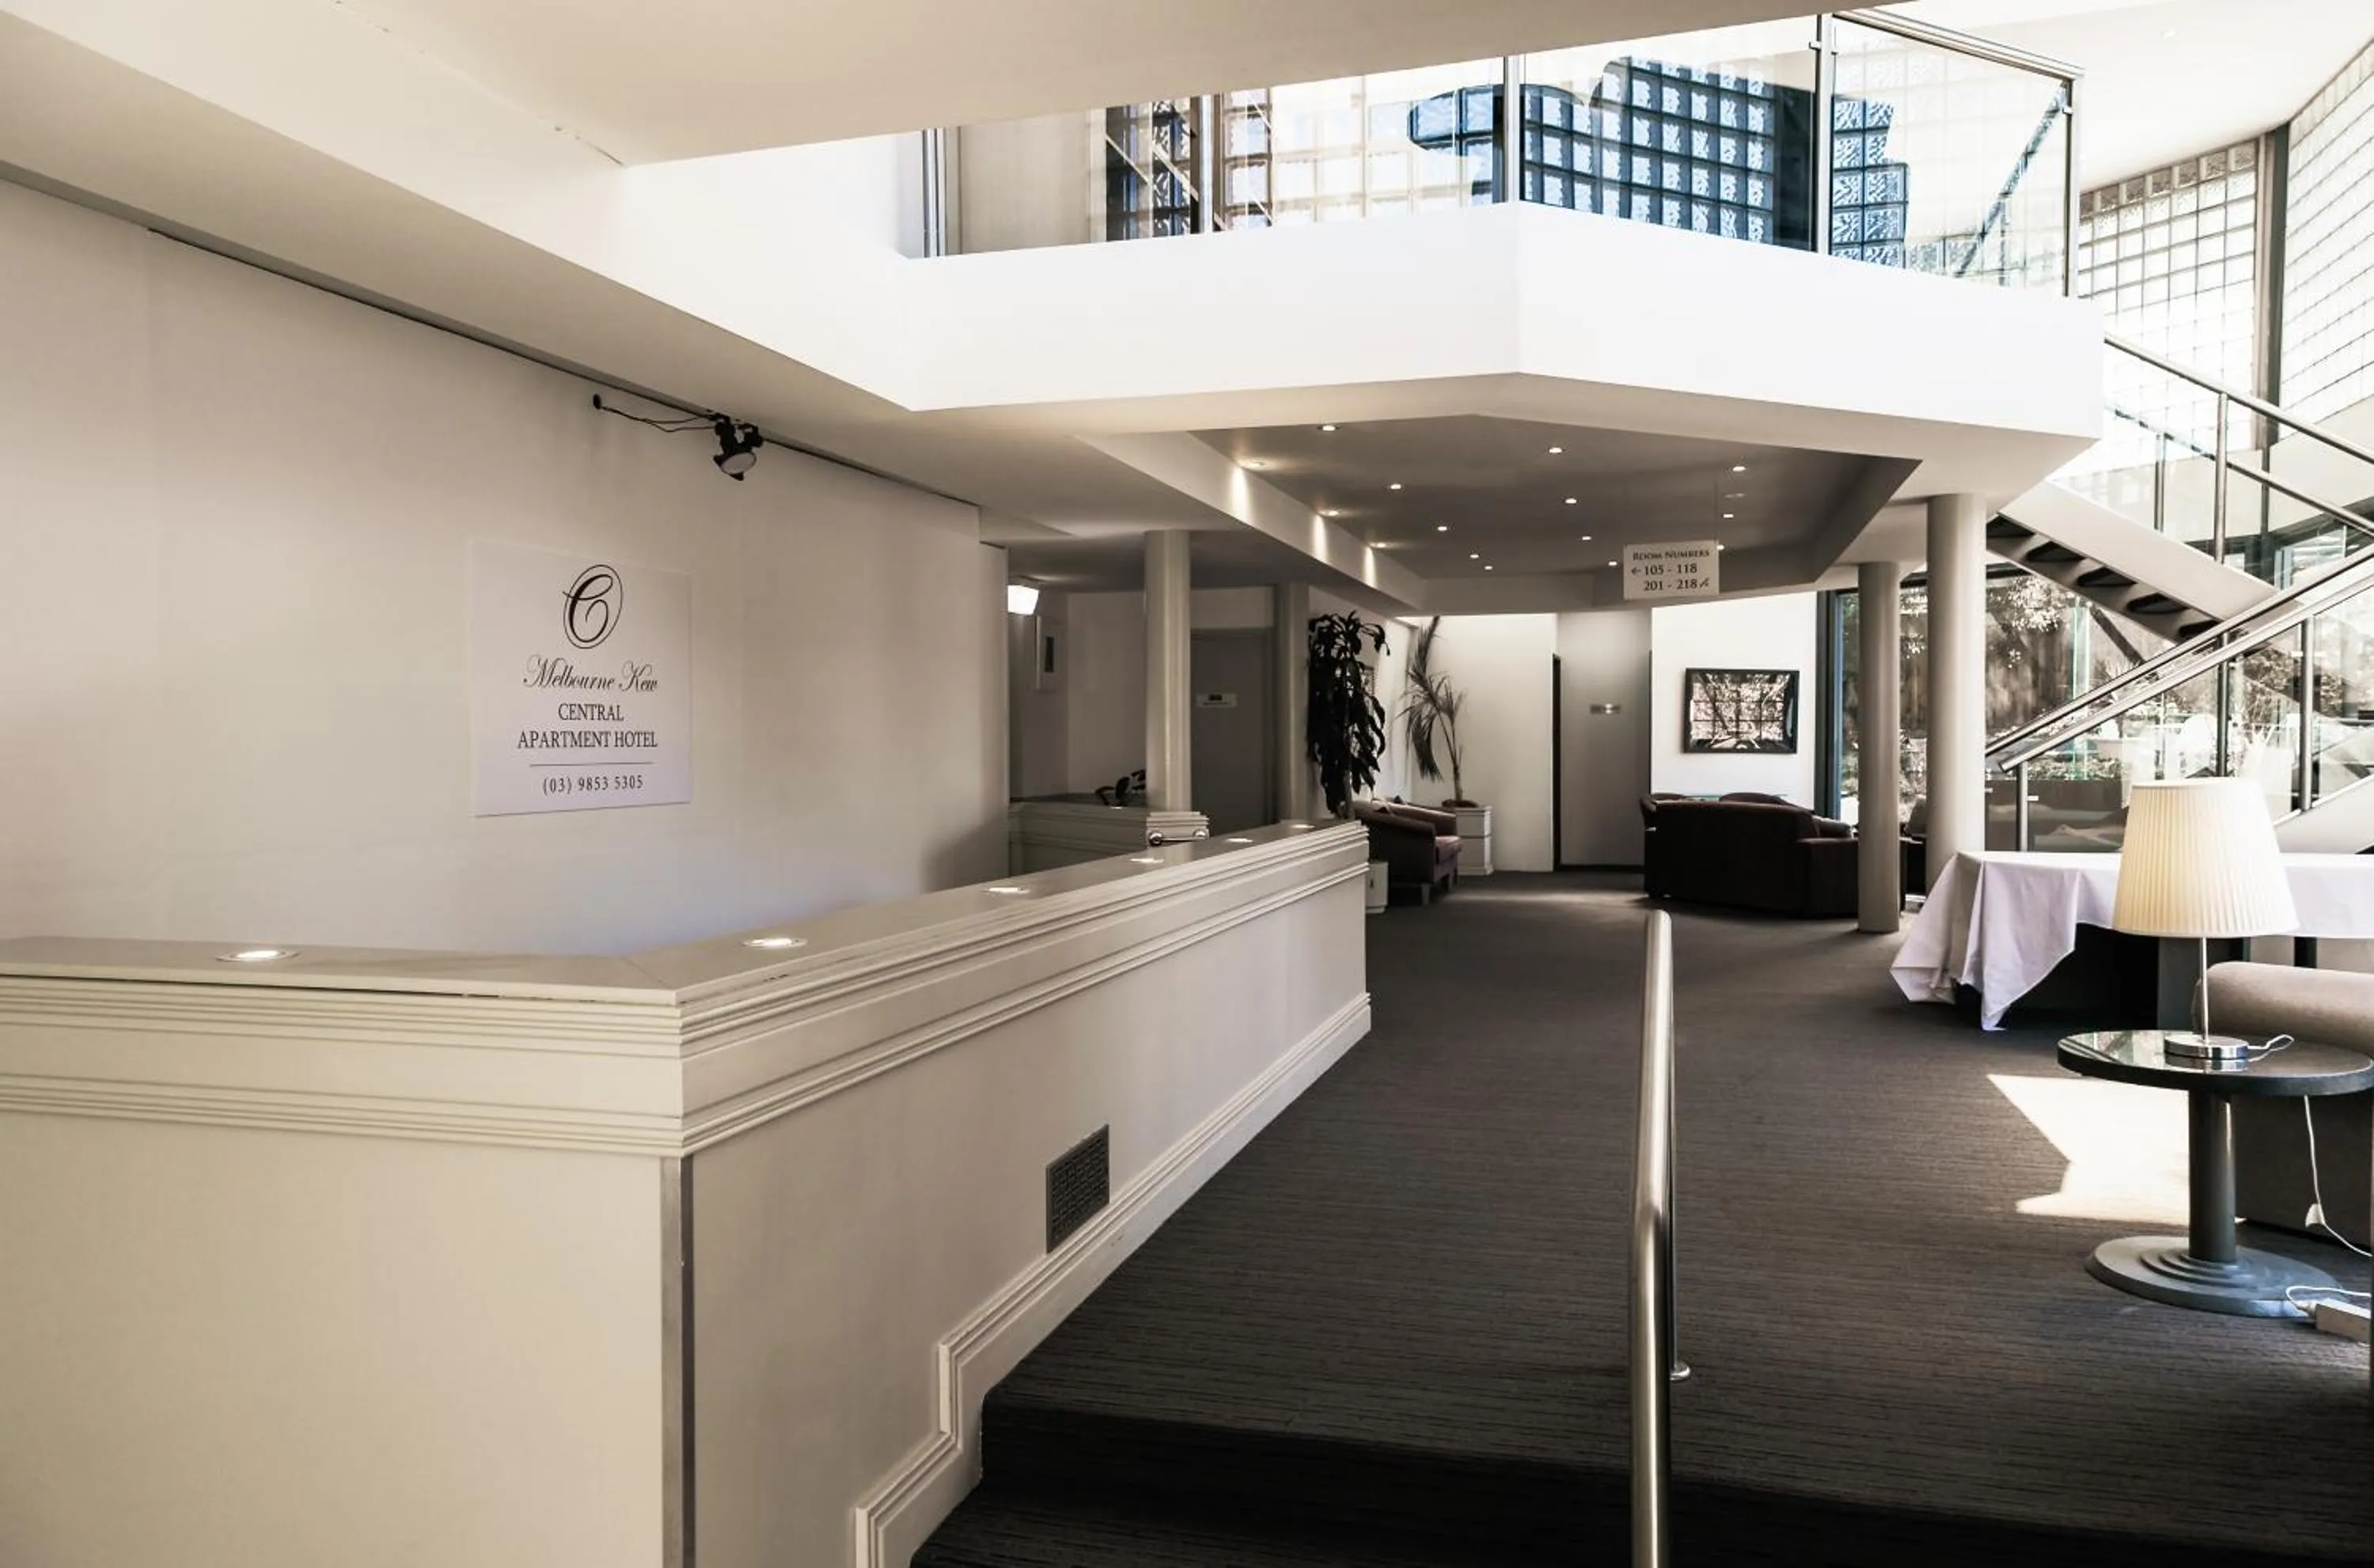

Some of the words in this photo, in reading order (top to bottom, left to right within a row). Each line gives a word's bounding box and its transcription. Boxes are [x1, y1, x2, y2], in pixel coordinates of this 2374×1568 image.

[1665, 549, 1710, 559] NUMBERS
[1644, 564, 1664, 575] 105
[1677, 563, 1697, 574] 118
[1644, 580, 1663, 591] 201
[1677, 578, 1697, 589] 218
[523, 654, 616, 690] Melbourne
[618, 659, 658, 692] Kew
[557, 703, 624, 722] CENTRAL
[516, 729, 611, 748] APARTMENT
[614, 731, 658, 748] HOTEL
[543, 777, 572, 795] (03)
[578, 776, 609, 792] 9853
[614, 775, 643, 790] 5305
